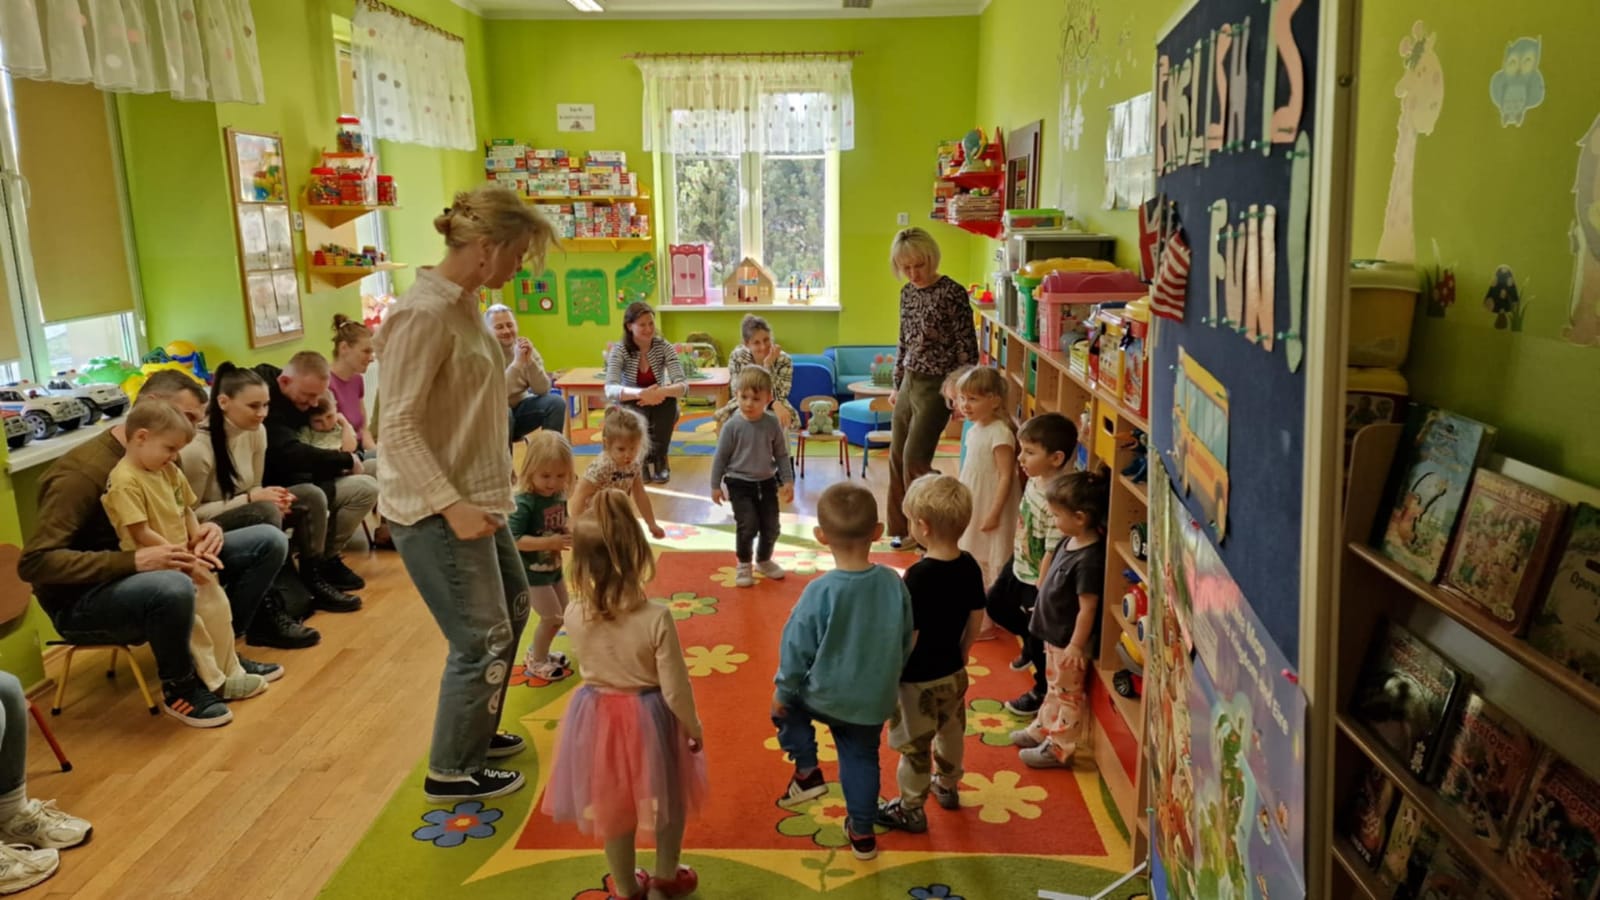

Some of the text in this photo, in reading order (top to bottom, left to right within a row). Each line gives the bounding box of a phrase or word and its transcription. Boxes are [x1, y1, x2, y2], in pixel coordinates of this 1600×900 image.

[1156, 0, 1304, 177] ENGLISH IS
[484, 768, 516, 779] NASA
